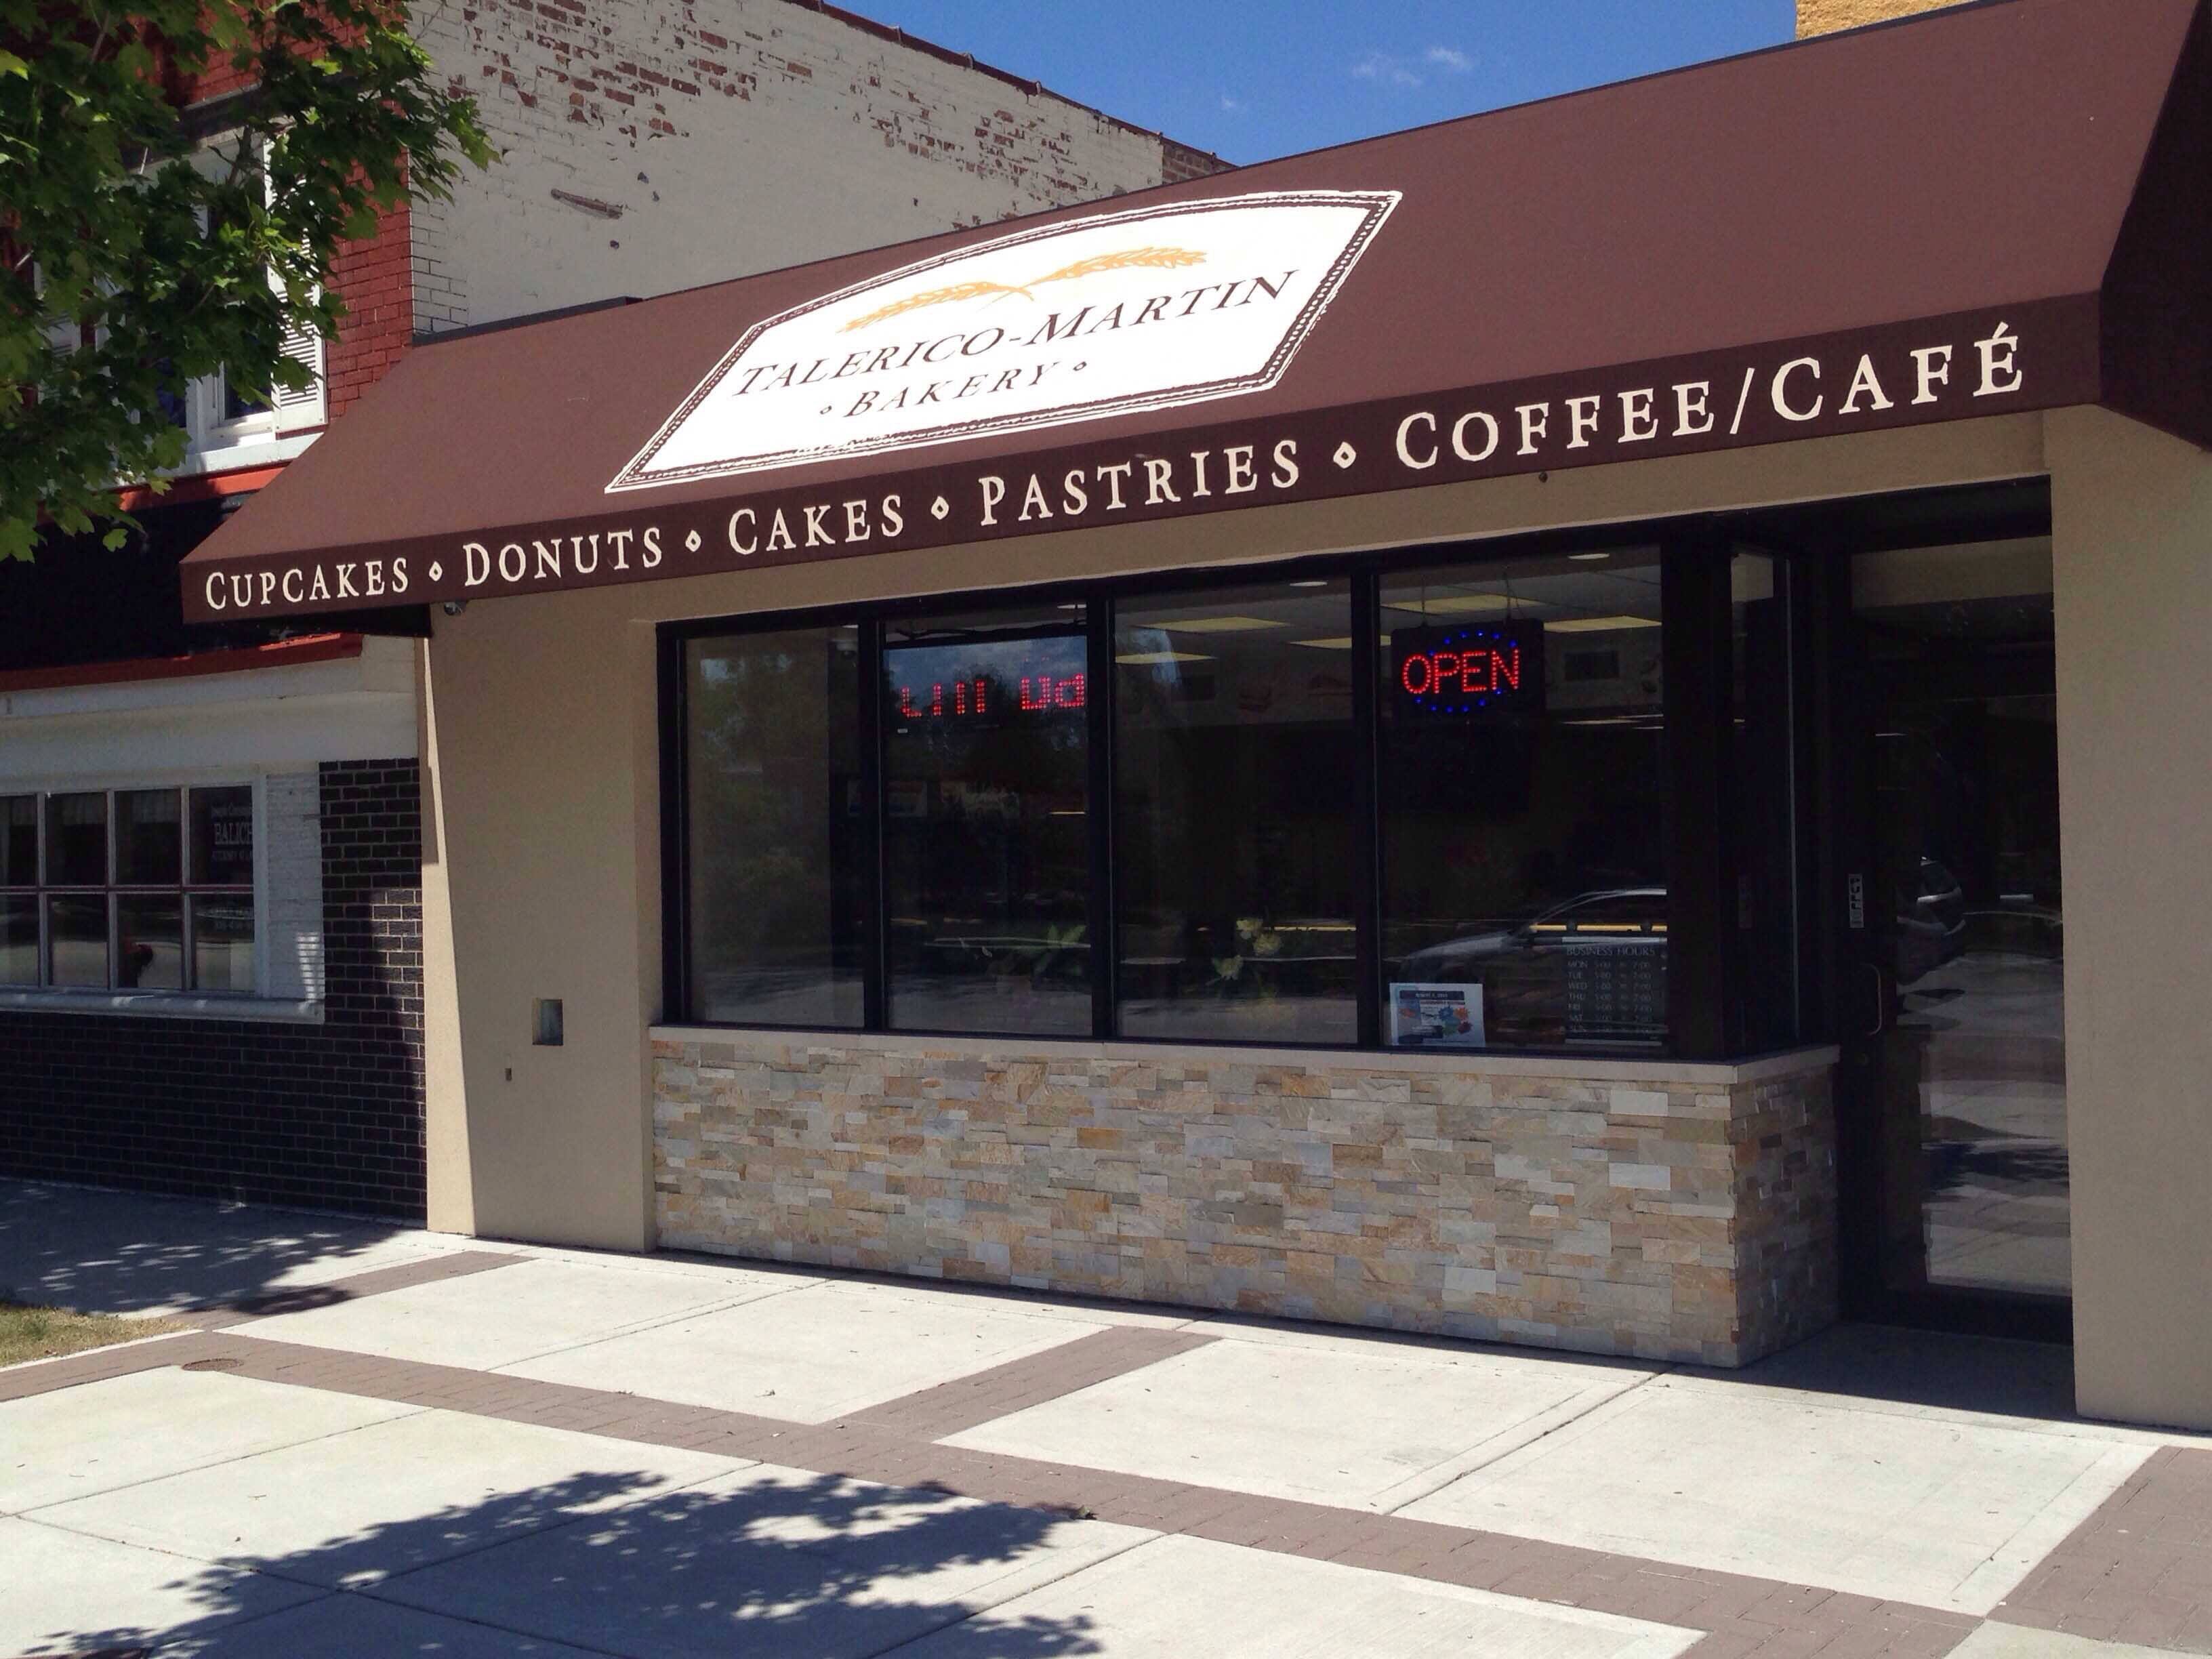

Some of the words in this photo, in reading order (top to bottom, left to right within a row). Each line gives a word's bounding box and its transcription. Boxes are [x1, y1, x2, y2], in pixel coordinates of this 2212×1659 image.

[735, 269, 1297, 397] TALERICO-MARTIN
[843, 361, 1065, 418] BAKERY
[205, 558, 409, 611] CUPCAKES
[462, 527, 663, 587] DONUTS
[728, 494, 904, 556] CAKES
[977, 439, 1299, 527] PASTRIES
[1395, 321, 2023, 470] COFFEE/CAFÉ
[1402, 648, 1523, 695] OPEN
[1849, 877, 1862, 909] PULL
[1566, 946, 1613, 956] BUSINESS
[1616, 945, 1656, 956] HOURS
